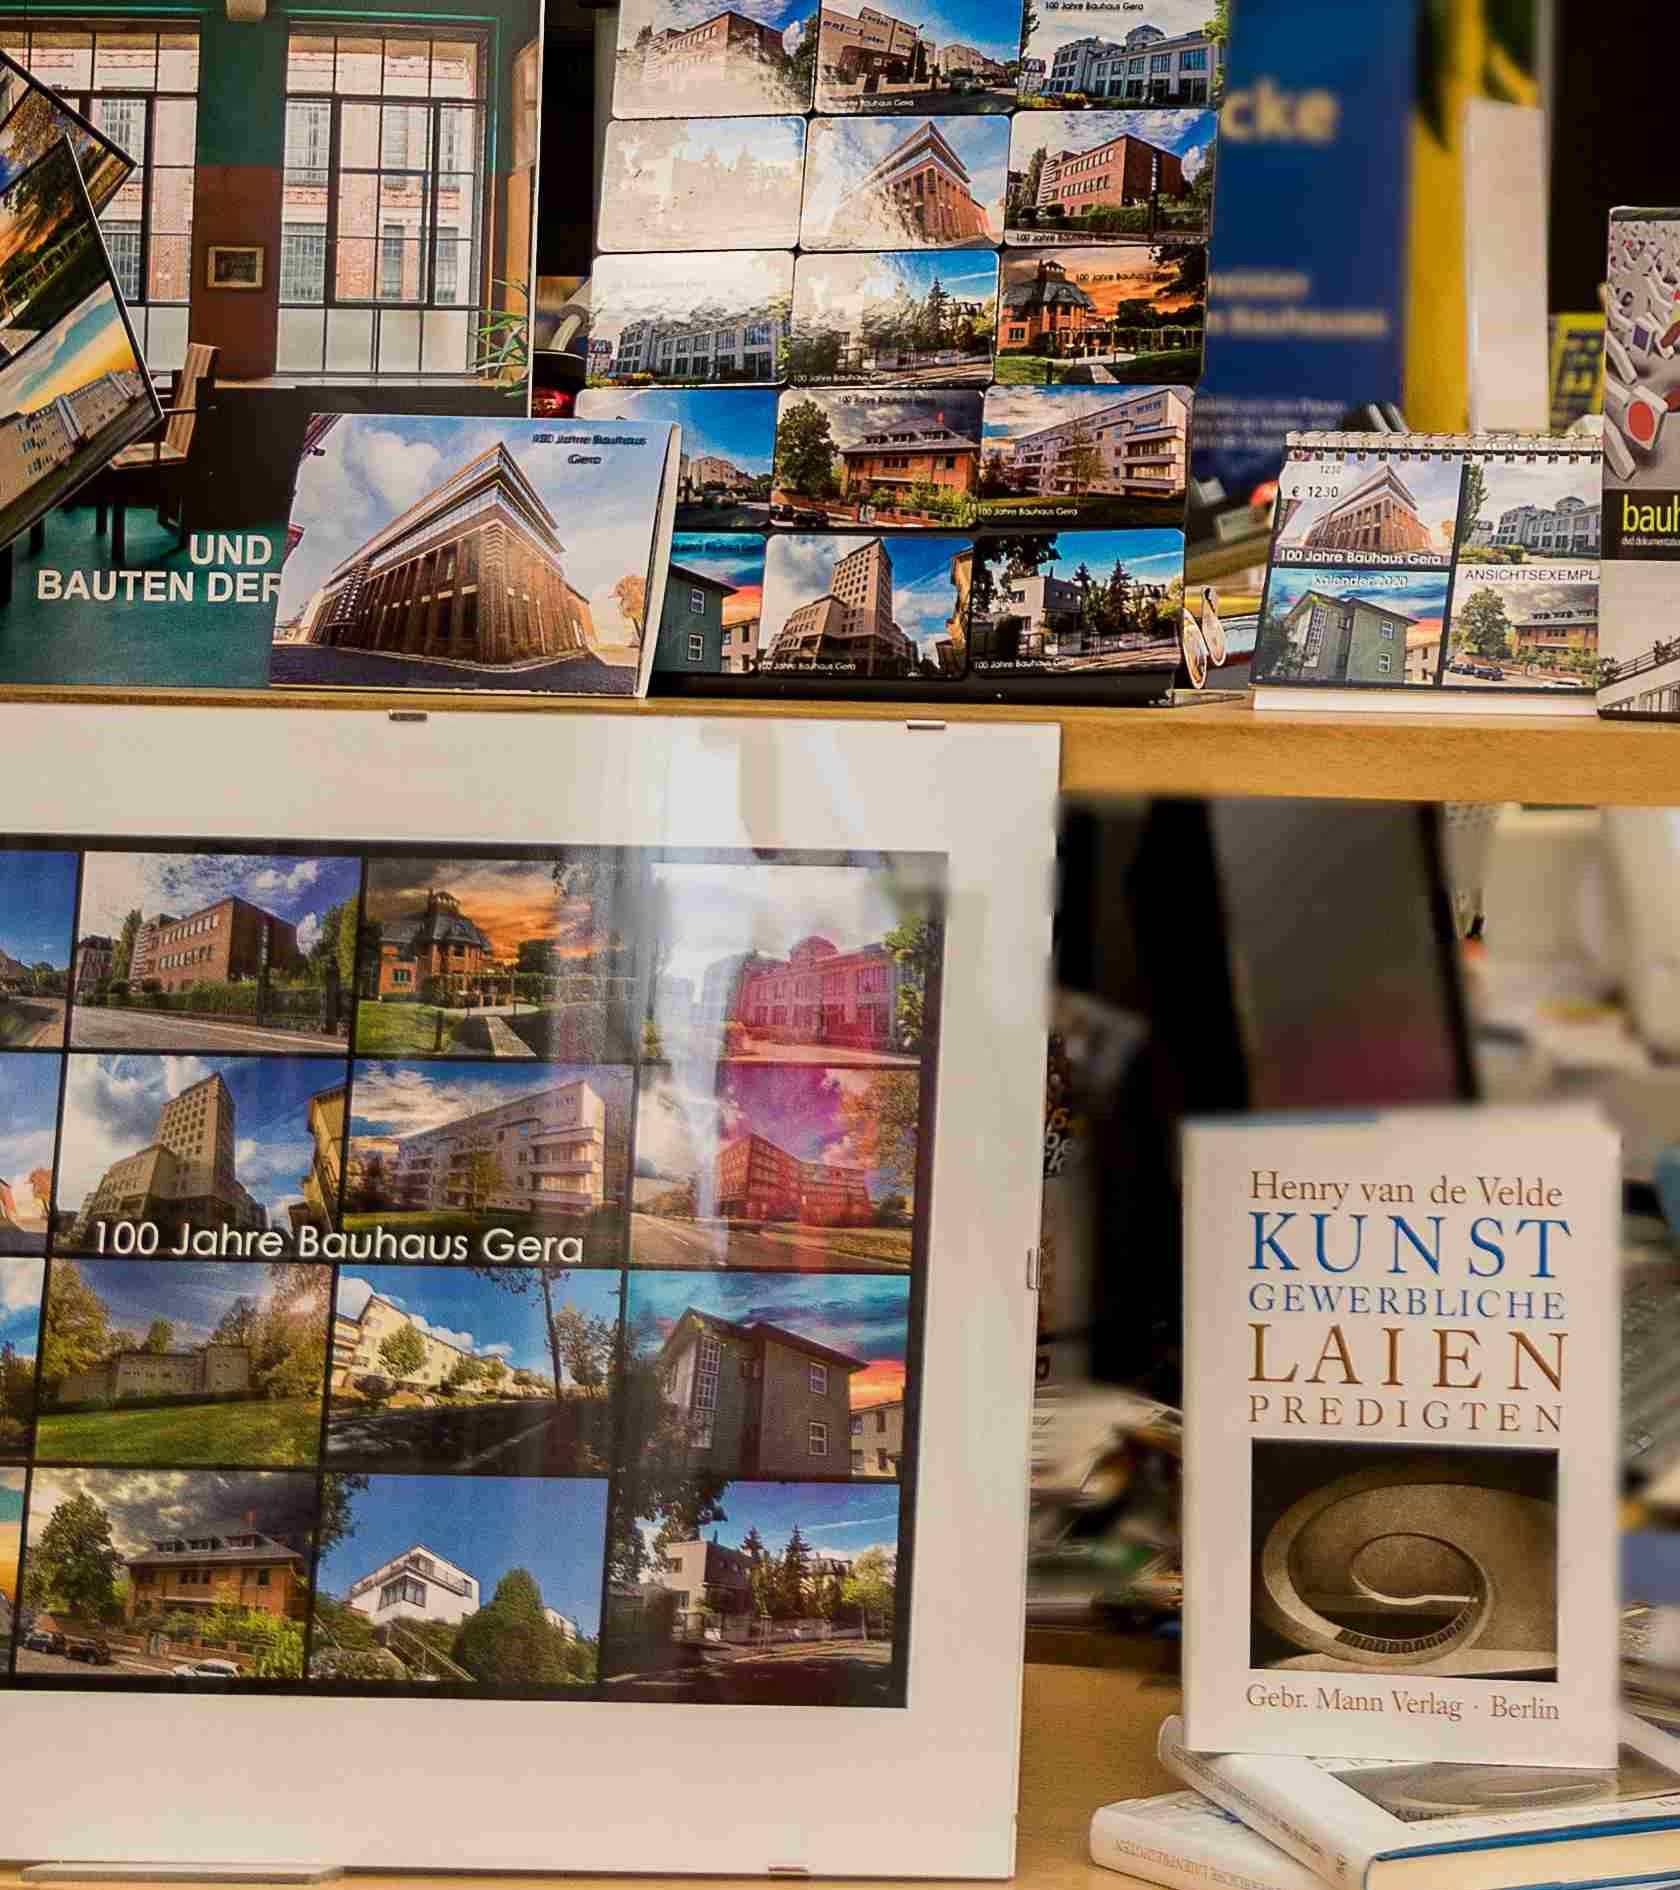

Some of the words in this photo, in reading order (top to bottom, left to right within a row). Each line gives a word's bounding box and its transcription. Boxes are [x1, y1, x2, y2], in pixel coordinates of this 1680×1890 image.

[1292, 487, 1300, 498] €
[190, 534, 273, 566] UND
[1280, 550, 1303, 563] 100
[1305, 550, 1344, 565] Jahre
[1346, 551, 1404, 566] Bauhaus
[1407, 552, 1442, 565] Gera
[37, 570, 194, 602] BAUTEN
[1250, 1170, 1350, 1210] Henry
[1360, 1181, 1414, 1205] van
[1430, 1176, 1467, 1205] de
[1477, 1177, 1564, 1207] Velde
[96, 1220, 158, 1256] 100
[171, 1221, 285, 1259] Jahre
[298, 1226, 469, 1261] Bauhaus
[481, 1228, 585, 1263] Gera
[1248, 1211, 1572, 1278] KUNST
[1249, 1283, 1567, 1321] GEWERBLICHE
[1248, 1322, 1569, 1393] LAIEN
[1248, 1394, 1562, 1433] PREDIGTEN
[1246, 1683, 1308, 1711] Gebr.
[1316, 1687, 1384, 1713] Mann
[1391, 1690, 1463, 1722] Verlag
[1488, 1694, 1560, 1721] Berlin
